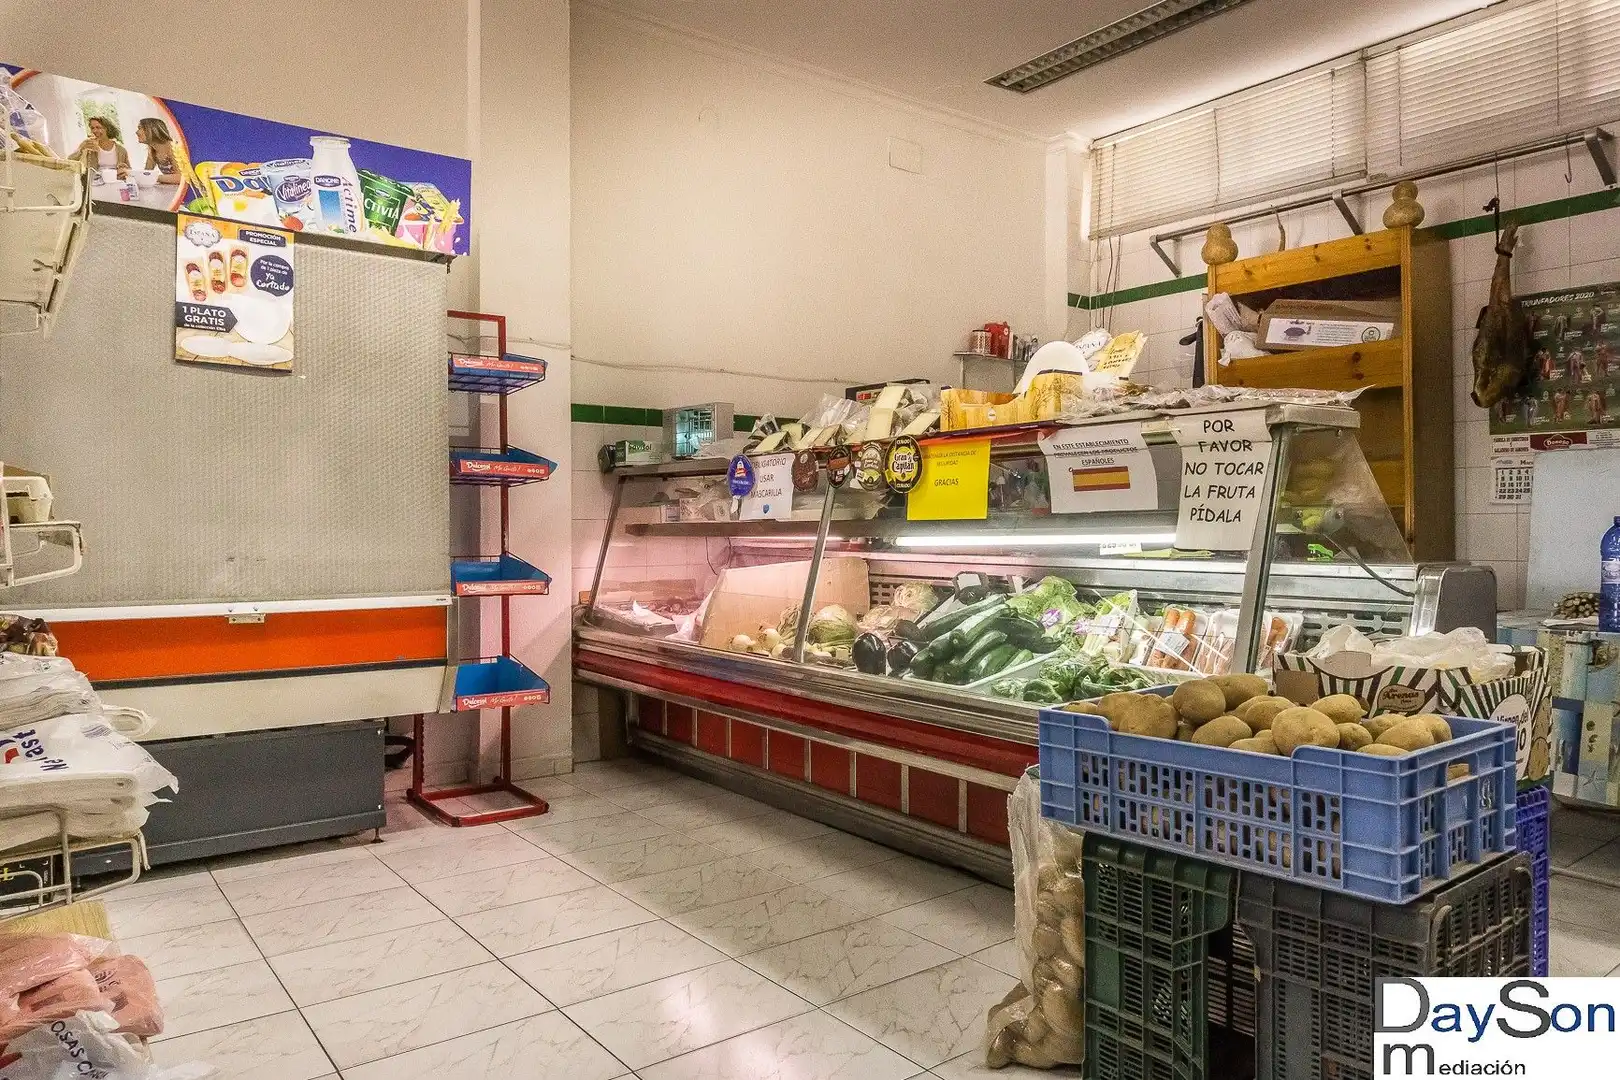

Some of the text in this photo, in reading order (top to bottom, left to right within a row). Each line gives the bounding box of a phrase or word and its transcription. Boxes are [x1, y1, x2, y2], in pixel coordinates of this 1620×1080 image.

[281, 179, 312, 201] Vitalinea
[342, 176, 357, 233] Actime
[364, 198, 399, 220] CTIVIA
[245, 230, 281, 241] PROMOCIÓN
[249, 237, 277, 246] ESPECIAL
[256, 280, 291, 291] Cortado
[1521, 294, 1574, 308] TRIUNFADORES
[1574, 291, 1595, 300] 2020
[182, 306, 227, 318] 1 PLATO
[184, 314, 225, 326] GRATIS
[1203, 419, 1235, 433] POR
[1075, 438, 1129, 449] ESTABLECIMIENTO
[1198, 439, 1253, 453] FAVOR
[1081, 457, 1115, 466] ESPAÑOLES
[1184, 461, 1265, 476] NO TOCAR
[759, 473, 775, 483] USAR
[934, 478, 959, 487] GRACIAS
[750, 488, 782, 499] MASCARILLA
[1183, 484, 1256, 499] LA FRUTA
[1190, 503, 1242, 523] PÍDALA
